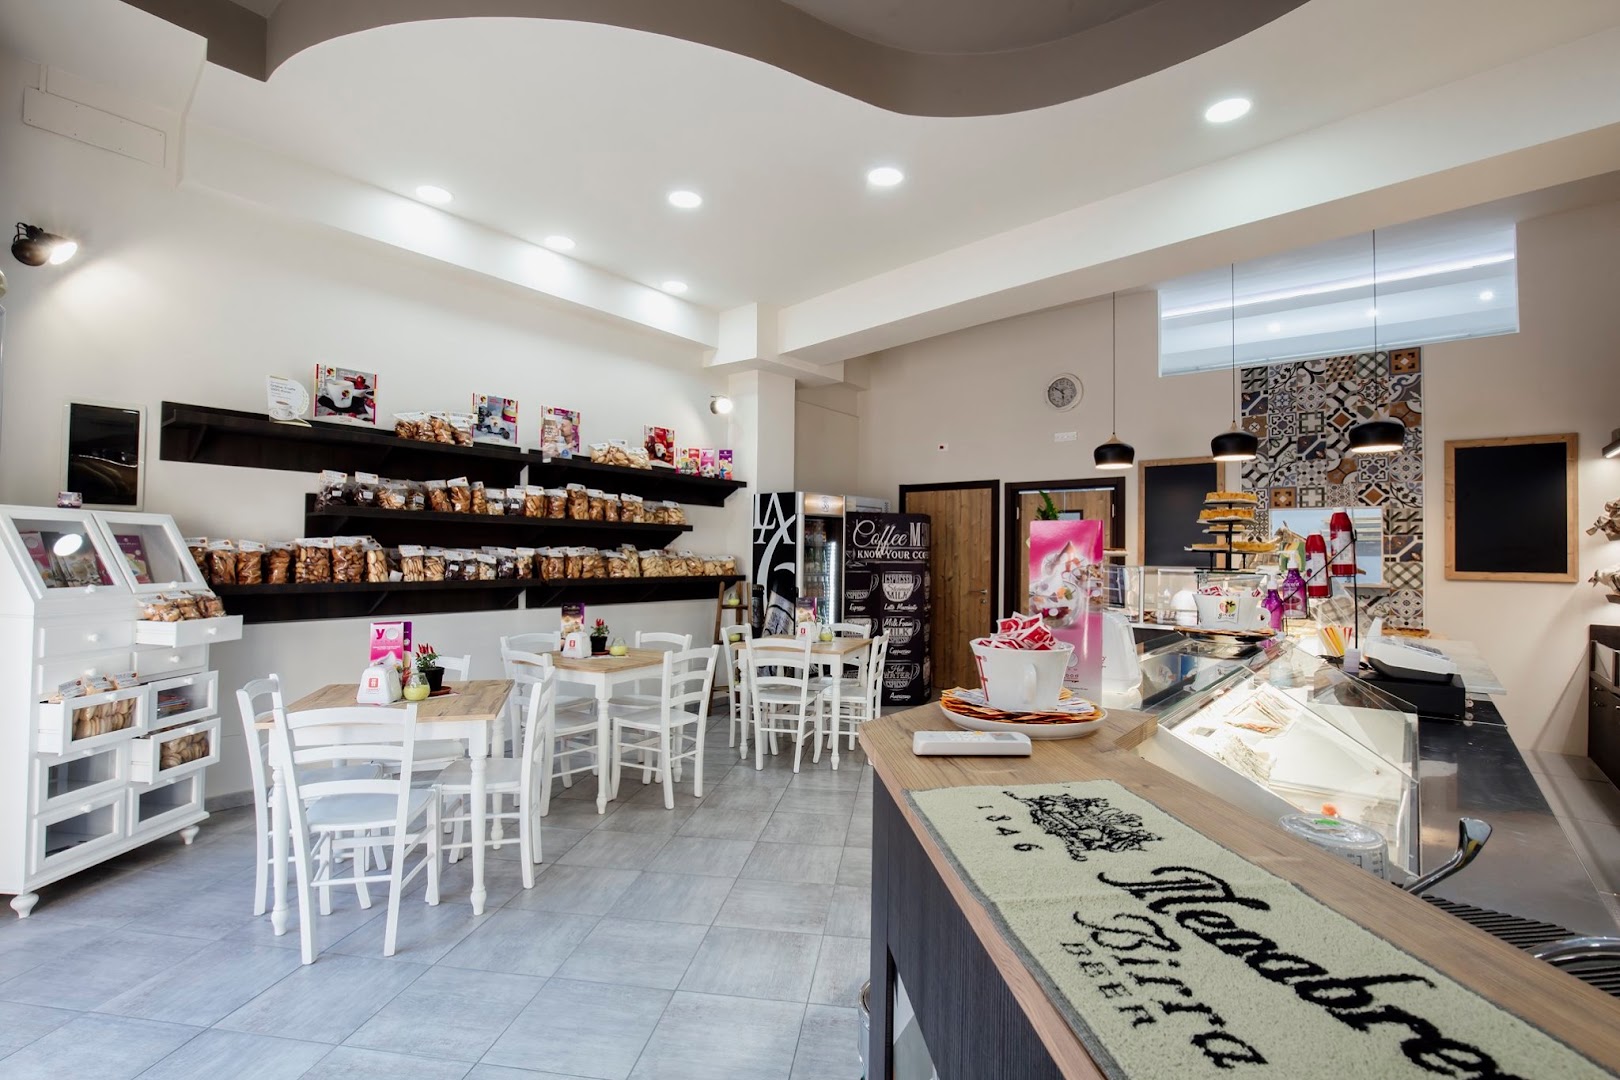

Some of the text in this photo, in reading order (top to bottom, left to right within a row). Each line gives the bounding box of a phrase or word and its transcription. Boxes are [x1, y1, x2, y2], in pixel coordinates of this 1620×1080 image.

[853, 519, 908, 555] Coffee
[857, 550, 882, 559] KNOW
[886, 550, 910, 559] YOUR
[1059, 942, 1157, 1028] BEER
[1072, 911, 1268, 1069] Birra
[1097, 866, 1534, 1080] Menabre
